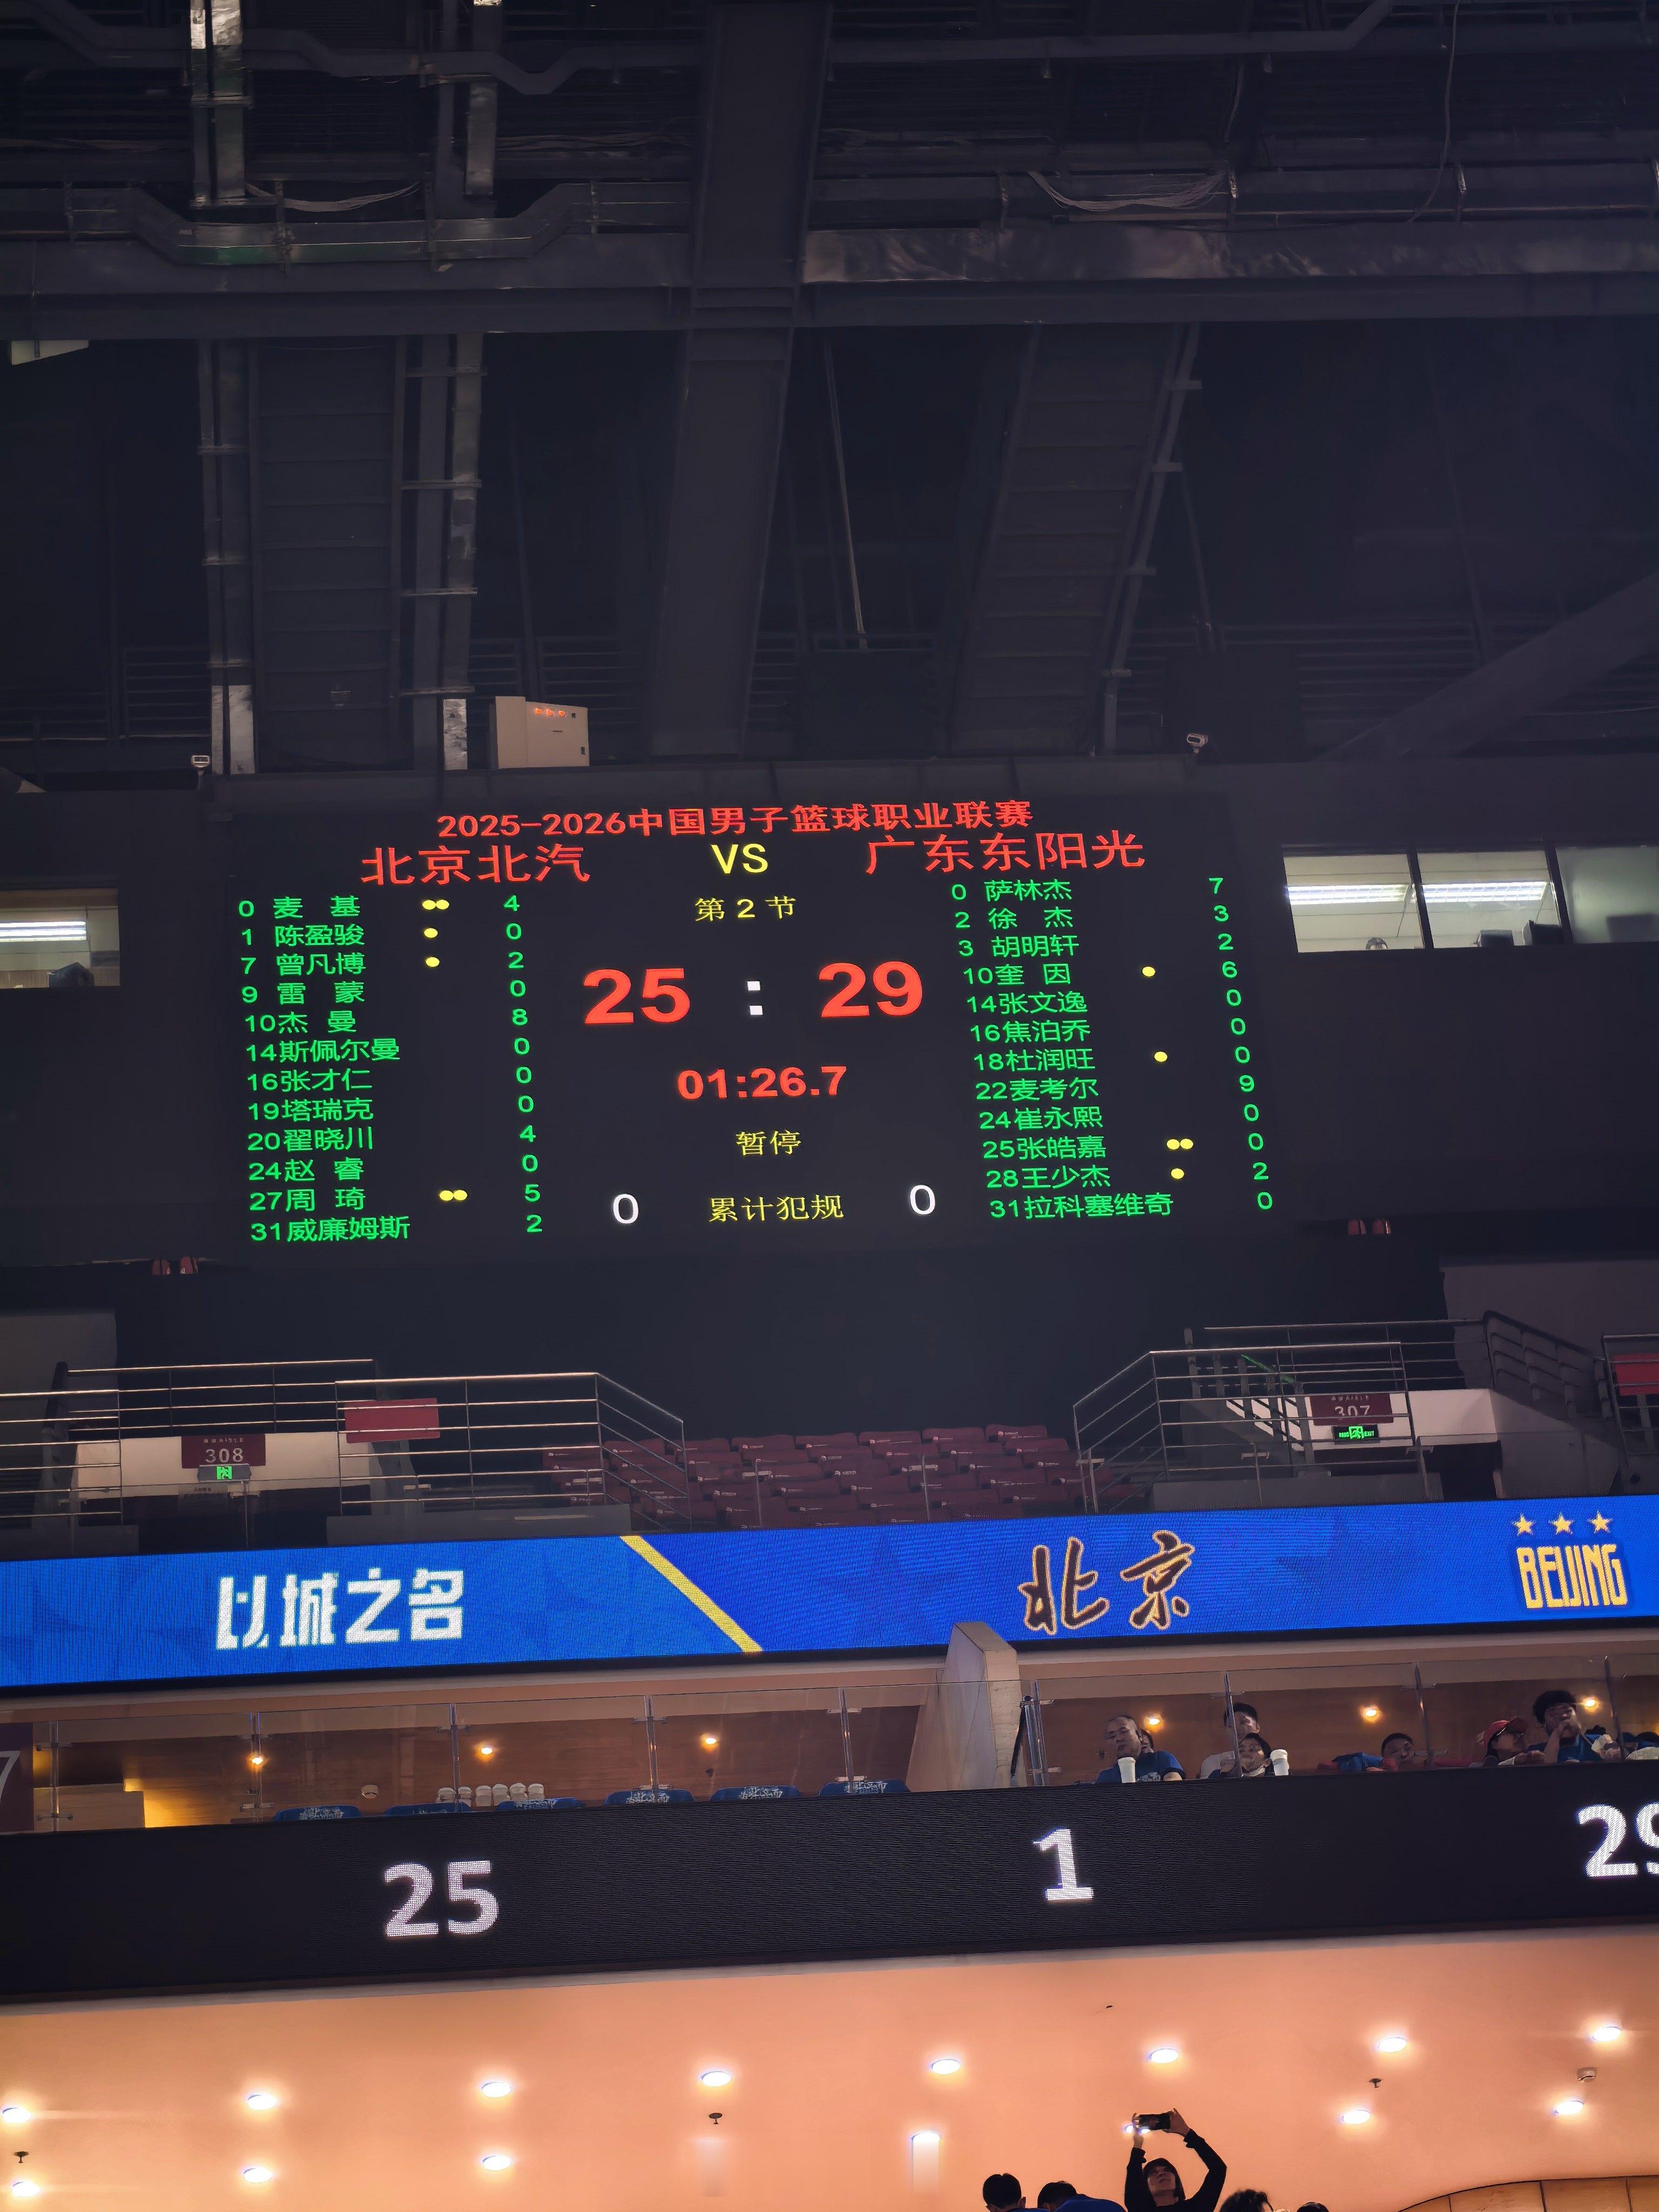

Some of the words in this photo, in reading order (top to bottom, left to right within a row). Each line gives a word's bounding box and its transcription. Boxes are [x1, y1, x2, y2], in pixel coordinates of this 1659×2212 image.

[711, 844, 767, 873] VS
[866, 828, 1144, 874] 广东东阳光
[361, 844, 590, 885] 北京北汽
[952, 885, 966, 900] 0
[984, 879, 1071, 901] 萨林杰
[1209, 878, 1223, 893] 7
[239, 901, 254, 916] 0
[273, 896, 302, 919] 麦
[331, 896, 360, 916] 基
[504, 895, 520, 911] 4
[695, 898, 724, 921] 第
[738, 899, 755, 918] 2
[765, 896, 795, 919] 节
[955, 912, 970, 928] 2
[988, 908, 1017, 929] 徐
[1044, 907, 1073, 927] 杰
[1214, 906, 1229, 921] 3
[242, 929, 251, 945] 1
[275, 924, 365, 947] 陈盈骏
[507, 923, 521, 939] 0
[959, 940, 973, 956] 3
[992, 935, 1079, 957] 胡明轩
[1218, 934, 1233, 949] 2
[241, 958, 256, 974] 7
[277, 953, 366, 975] 曾凡博
[509, 952, 523, 968] 2
[1043, 964, 1070, 984] 因
[1223, 961, 1237, 977] 6
[242, 987, 257, 1002] 9
[278, 983, 306, 1004] 雷
[334, 981, 365, 1003] 蒙
[510, 980, 525, 996] 0
[584, 968, 690, 1024] 25
[819, 961, 922, 1018] 29
[1227, 989, 1241, 1006] 0
[328, 1011, 356, 1033] 曼
[512, 1009, 527, 1025] 8
[1231, 1018, 1245, 1035] 0
[515, 1038, 529, 1054] 0
[1236, 1047, 1250, 1063] 0
[516, 1067, 531, 1083] 0
[678, 1067, 846, 1099] 01:26.7
[1239, 1075, 1254, 1091] 9
[518, 1096, 534, 1112] 0
[1244, 1104, 1258, 1121] 0
[520, 1125, 536, 1142] 4
[736, 1130, 801, 1155] 暂停
[1249, 1133, 1263, 1150] 0
[335, 1157, 363, 1180] 睿
[523, 1155, 537, 1171] 0
[1253, 1162, 1268, 1179] 2
[335, 1187, 366, 1210] 琦
[525, 1184, 540, 1202] 5
[613, 1194, 638, 1224] 0
[710, 1195, 844, 1222] 累计犯规
[910, 1185, 935, 1215] 0
[1258, 1192, 1272, 1209] 0
[527, 1215, 542, 1232] 2
[206, 1448, 243, 1463] 308
[1017, 1530, 1195, 1635] 北京
[1516, 1543, 1628, 1608] BEIJING
[216, 1568, 464, 1650] 以城之名
[1033, 1827, 1094, 1900] 1
[384, 1860, 499, 1937] 25
